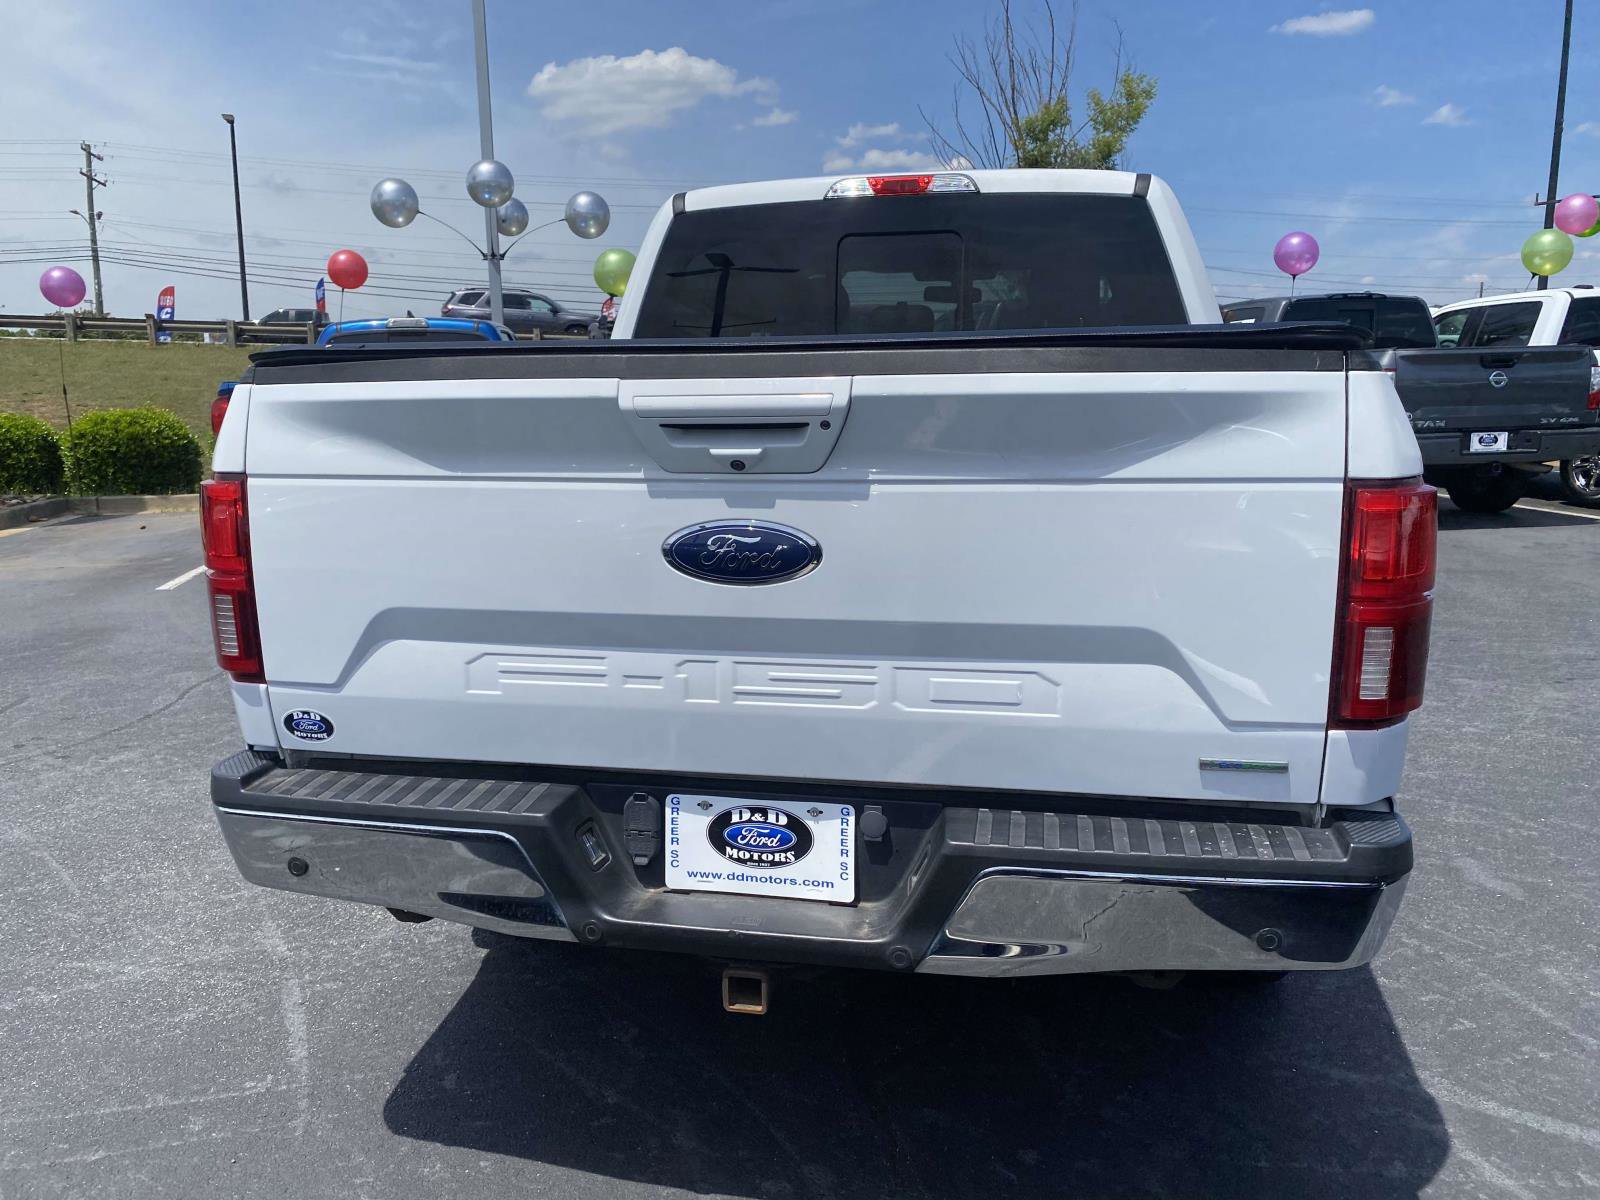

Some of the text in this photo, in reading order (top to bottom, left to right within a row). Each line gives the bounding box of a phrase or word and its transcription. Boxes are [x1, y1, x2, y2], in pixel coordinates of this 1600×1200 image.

[700, 534, 788, 570] Ford
[465, 652, 1063, 719] F-150
[293, 711, 321, 720] D&D
[294, 730, 328, 739] MOTORS
[299, 721, 319, 731] Ford
[730, 808, 788, 826] D&D
[670, 796, 681, 868] GREER SC
[737, 826, 781, 847] Ford
[840, 807, 850, 881] GREER SC
[725, 845, 796, 863] MOTORS
[687, 870, 835, 889] www.ddmotors.com
